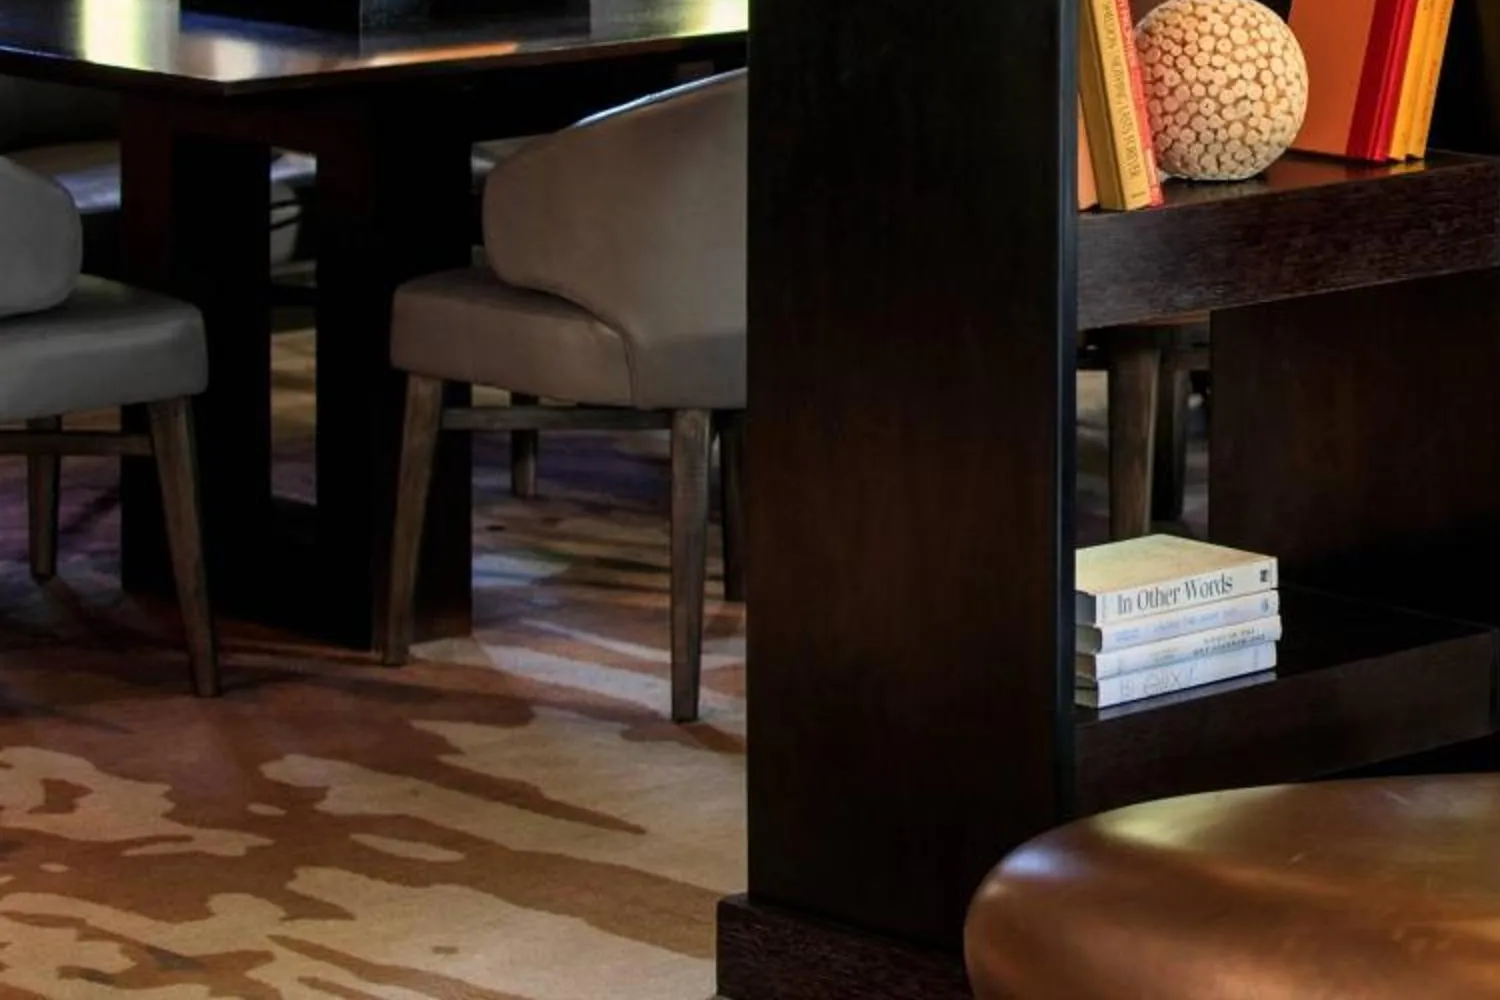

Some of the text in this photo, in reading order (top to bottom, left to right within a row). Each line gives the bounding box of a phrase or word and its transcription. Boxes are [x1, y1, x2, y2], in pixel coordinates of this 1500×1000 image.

[1117, 572, 1234, 615] In Other Words
